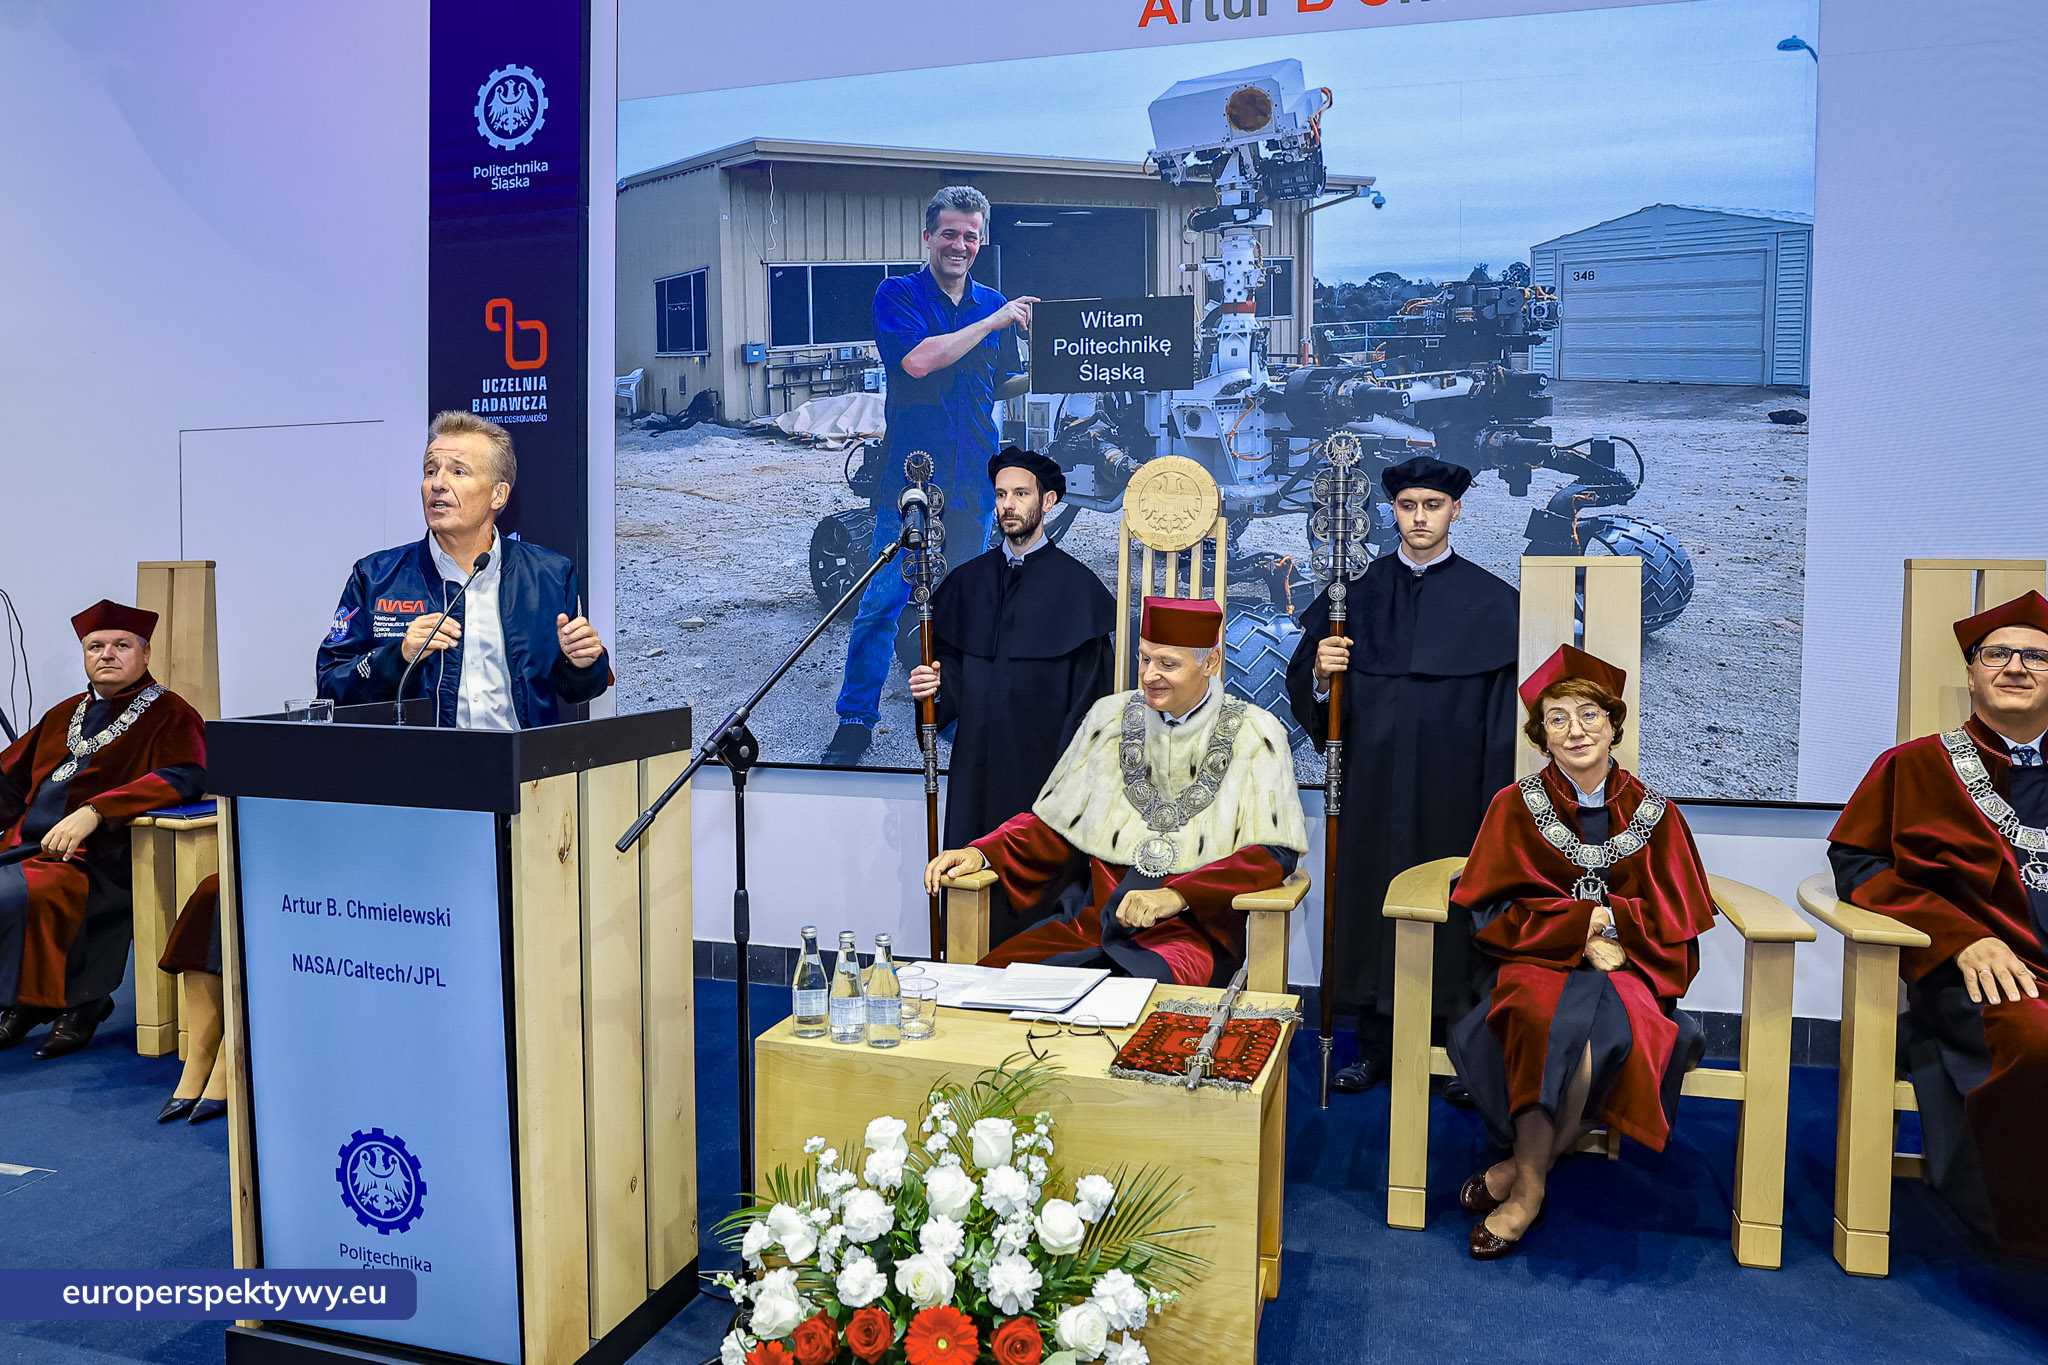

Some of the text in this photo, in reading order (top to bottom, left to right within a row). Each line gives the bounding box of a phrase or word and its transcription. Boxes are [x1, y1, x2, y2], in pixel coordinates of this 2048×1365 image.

[473, 160, 549, 179] Politechnika
[491, 175, 530, 191] Śląska
[1573, 270, 1595, 282] 348
[1080, 310, 1143, 328] Witam
[1053, 335, 1172, 356] Politechnikę
[1079, 360, 1146, 385] Śląską
[482, 375, 548, 393] UCZELNIA
[472, 395, 548, 413] BADAWCZA
[377, 598, 425, 613] NASA
[281, 893, 451, 927] Artur B. Chmielewski
[292, 953, 447, 988] NASA/Caltech/JPL
[339, 1242, 432, 1273] Politechnika
